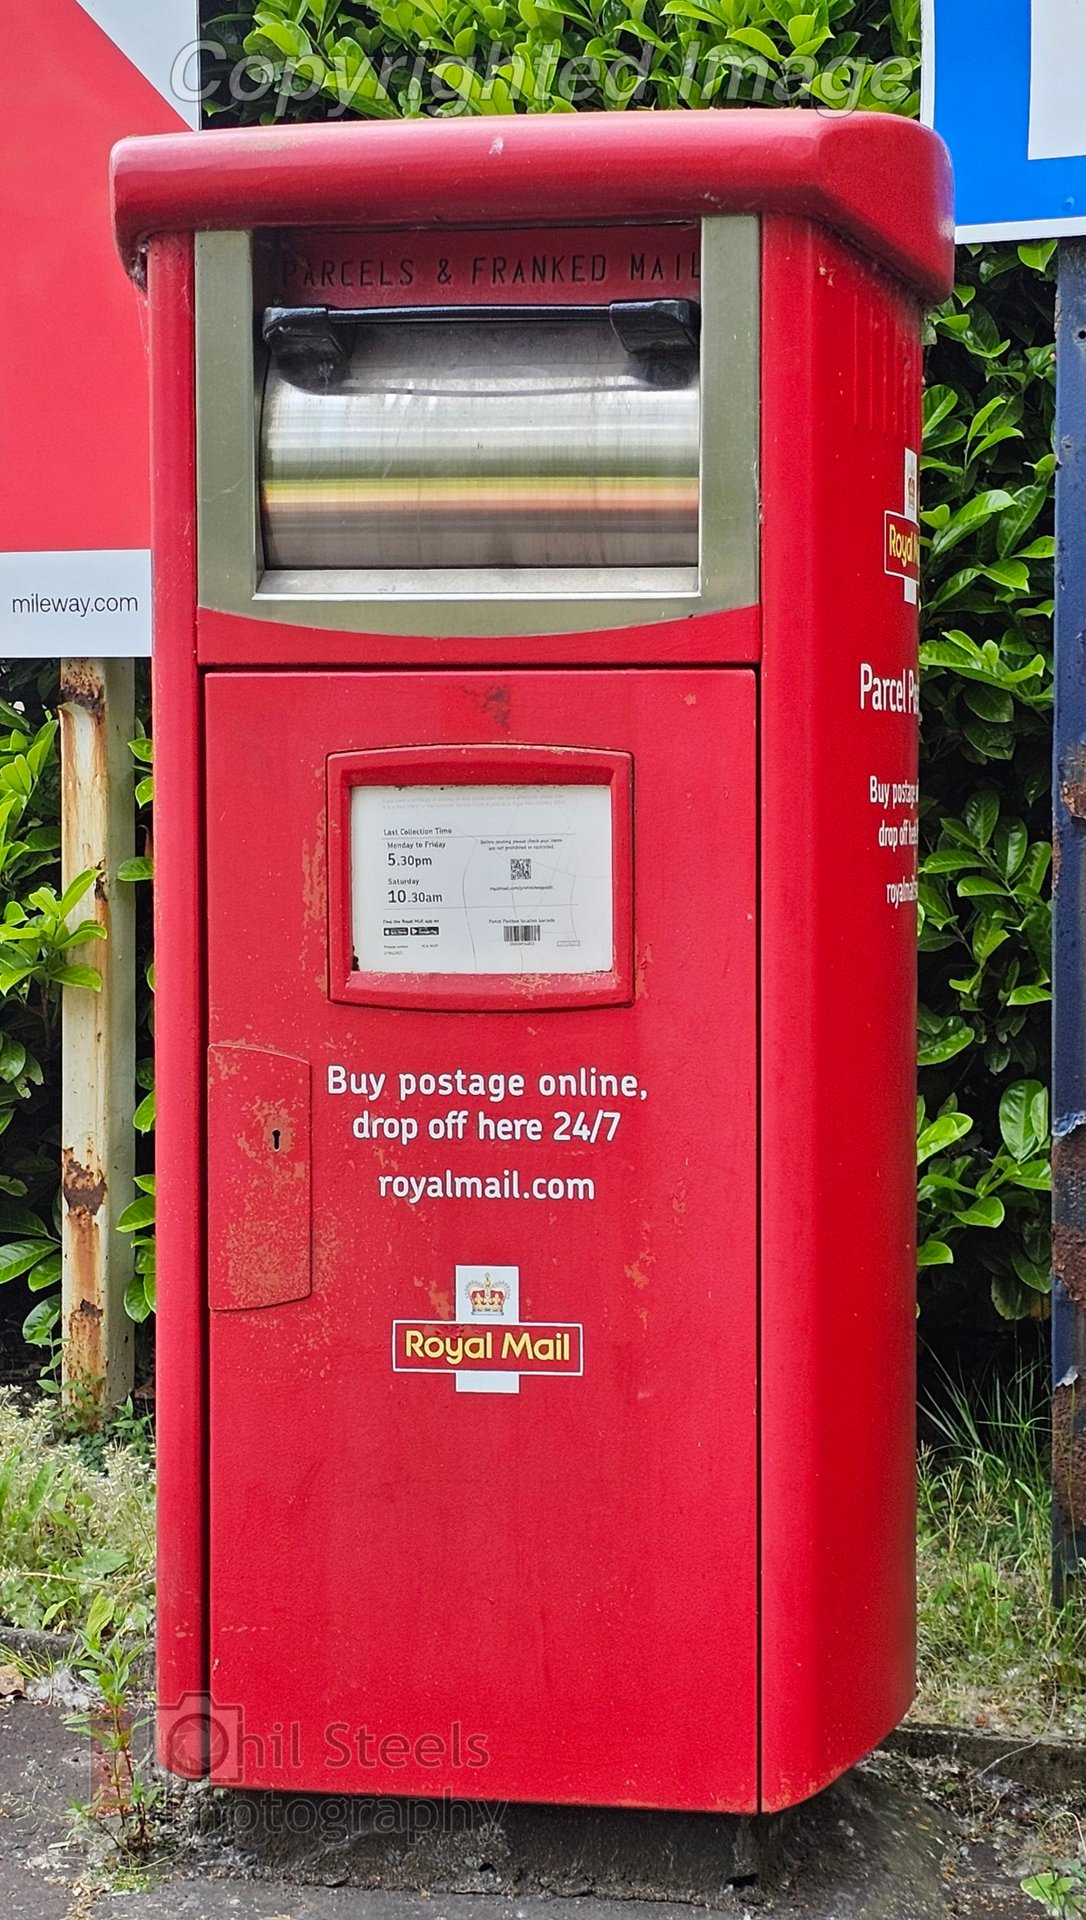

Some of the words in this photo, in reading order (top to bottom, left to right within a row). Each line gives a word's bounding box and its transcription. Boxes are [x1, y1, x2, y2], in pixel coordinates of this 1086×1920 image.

[282, 258, 414, 288] PARCELS
[437, 257, 452, 286] &
[472, 254, 607, 284] FRANKED
[630, 252, 701, 281] MAIL
[12, 593, 138, 617] mileway.com
[860, 662, 906, 713] Parcel
[869, 775, 890, 810] Buy
[383, 828, 398, 836] Last
[400, 827, 433, 836] Collection
[434, 827, 452, 835] Time
[425, 840, 446, 849] Friday
[879, 819, 898, 852] drop
[388, 852, 433, 868] 5.30pm
[388, 878, 420, 886] Saturday
[388, 889, 443, 903] 10.30am
[327, 1064, 386, 1101] Buy
[399, 1068, 525, 1102] postage
[538, 1068, 648, 1100] online,
[352, 1110, 418, 1145] drop
[428, 1110, 469, 1140] off
[477, 1111, 543, 1140] here
[552, 1109, 622, 1144] 24/7
[378, 1169, 595, 1204] royalmail.com
[405, 1330, 492, 1365] Royal
[501, 1332, 570, 1361] Mail
